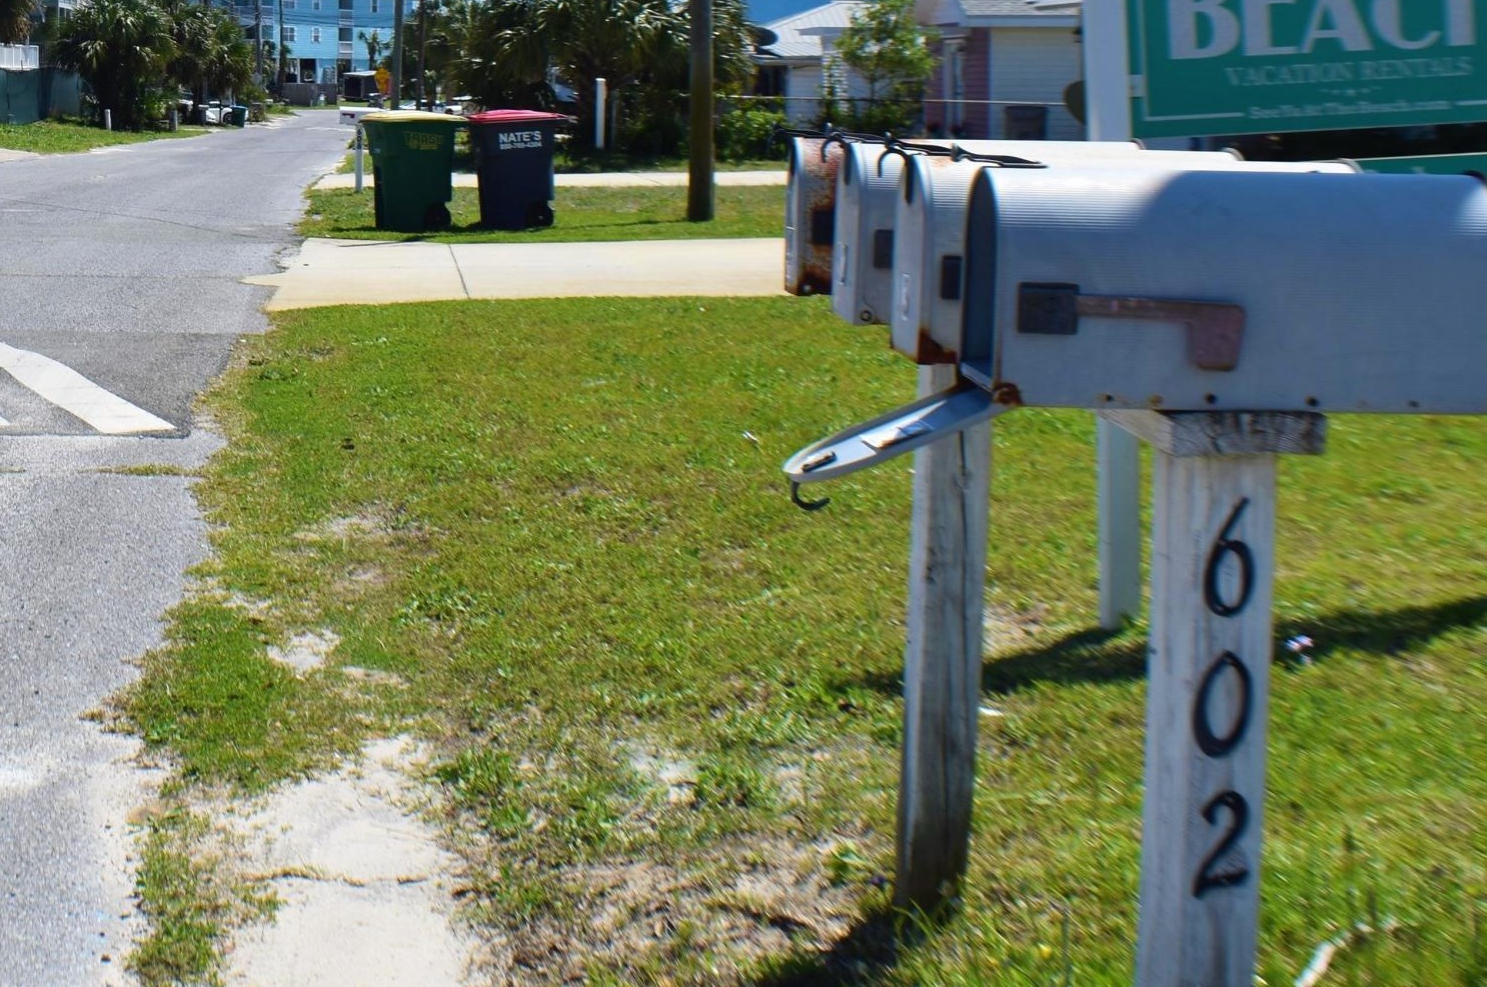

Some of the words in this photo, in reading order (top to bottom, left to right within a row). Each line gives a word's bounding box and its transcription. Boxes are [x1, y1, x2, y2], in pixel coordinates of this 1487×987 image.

[1224, 62, 1355, 87] VACATION
[1359, 56, 1475, 81] RENTALS
[498, 130, 543, 143] NATE'S
[1192, 497, 1255, 898] 602
